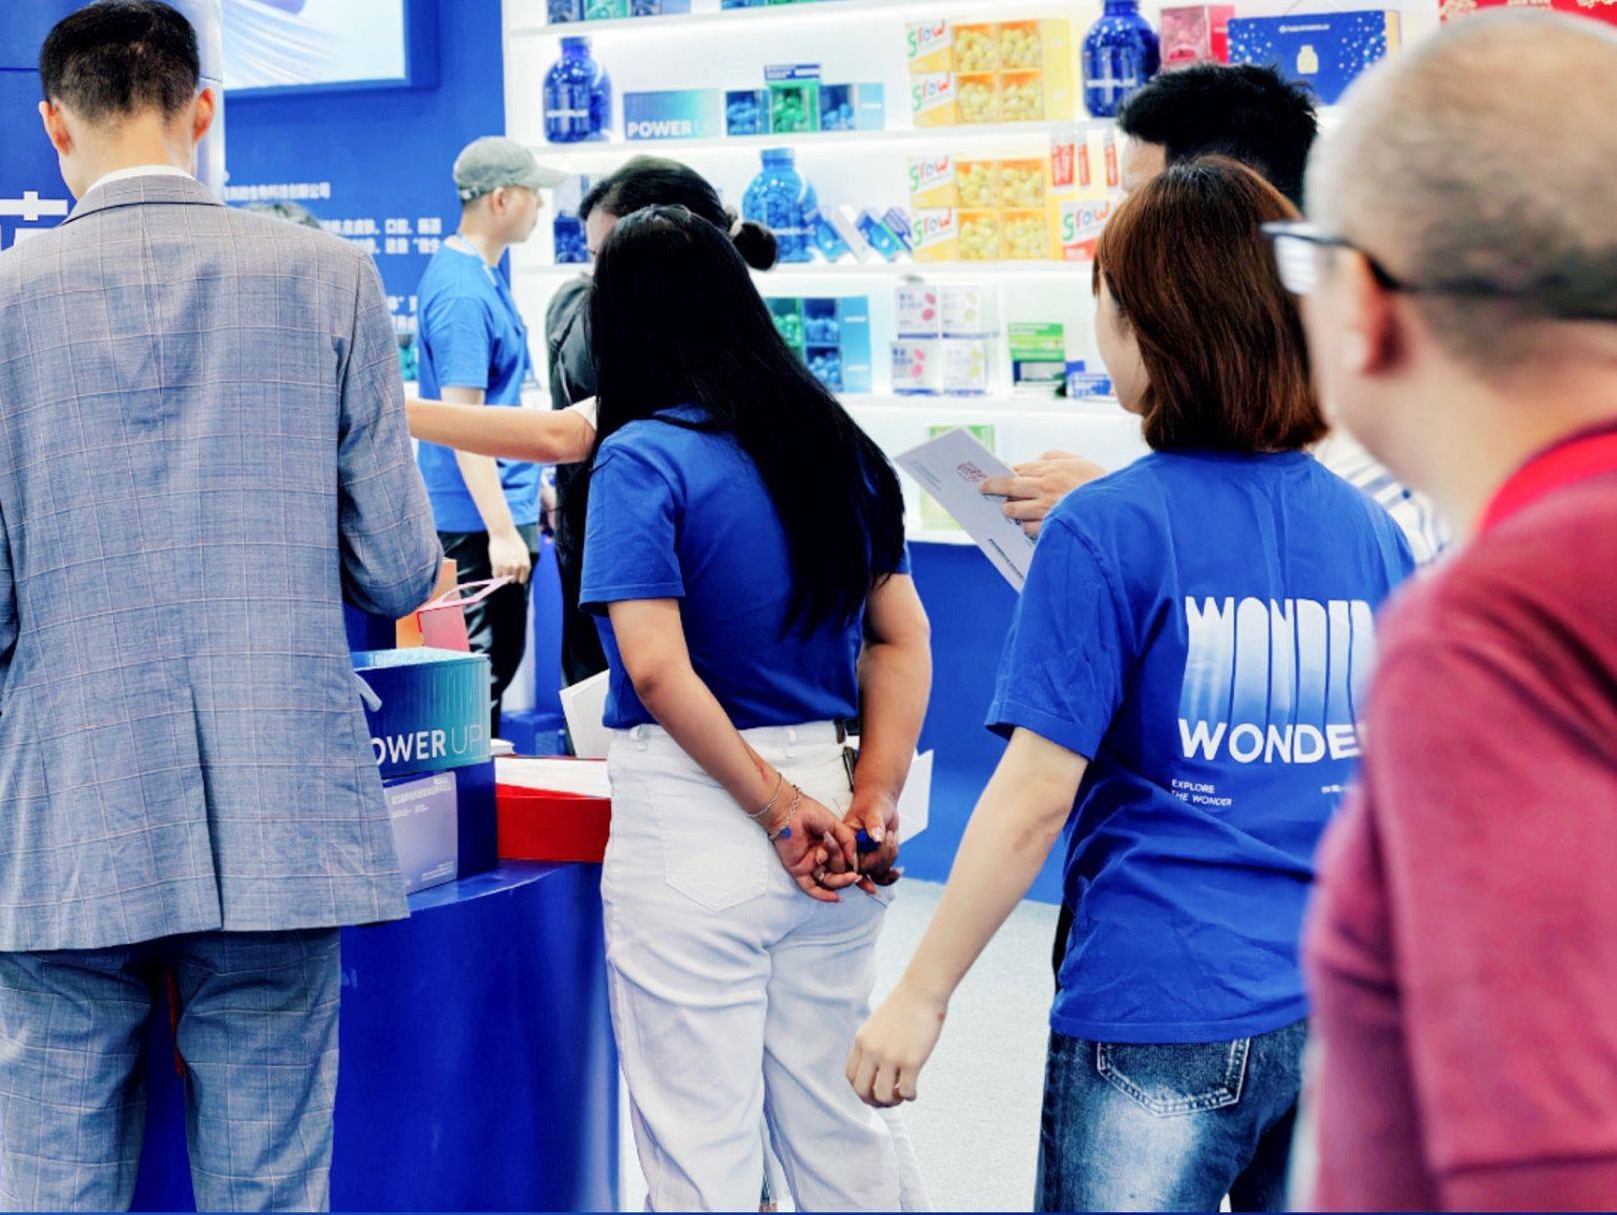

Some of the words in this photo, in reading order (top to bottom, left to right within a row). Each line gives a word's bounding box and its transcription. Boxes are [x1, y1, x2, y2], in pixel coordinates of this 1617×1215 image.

[627, 120, 692, 137] POWER
[370, 729, 447, 766] OWER
[451, 724, 483, 755] UP
[1171, 778, 1215, 794] EXPLORE
[1192, 794, 1232, 806] WONDER
